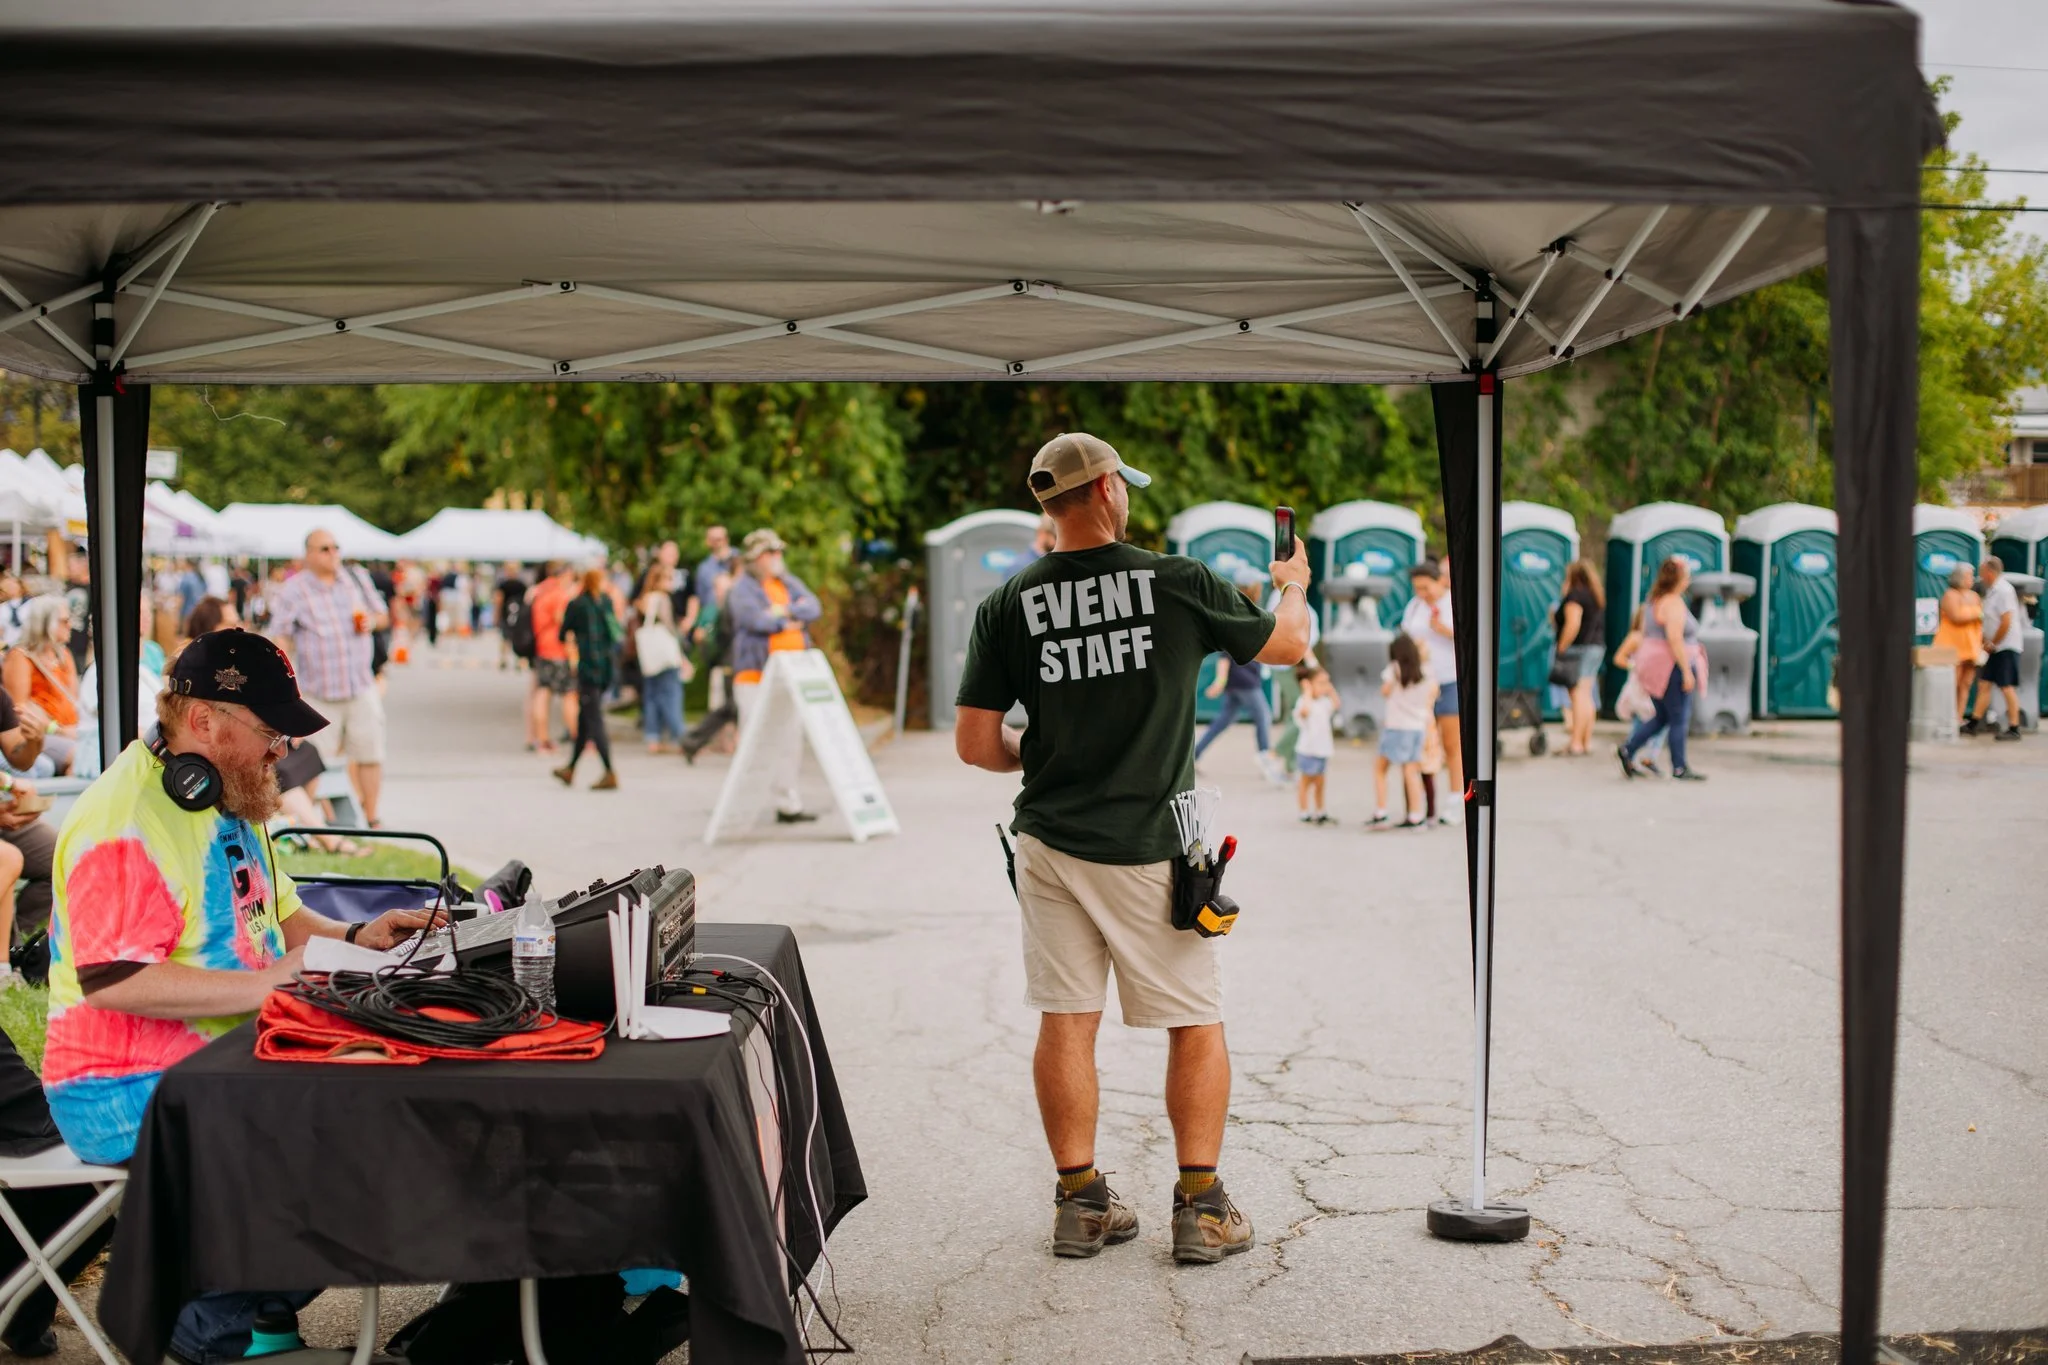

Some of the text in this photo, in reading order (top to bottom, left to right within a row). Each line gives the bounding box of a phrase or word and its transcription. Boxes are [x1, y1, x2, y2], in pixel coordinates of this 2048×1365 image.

[1020, 569, 1156, 637] EVENT
[1039, 625, 1153, 683] STAFF
[240, 898, 266, 924] TOWN
